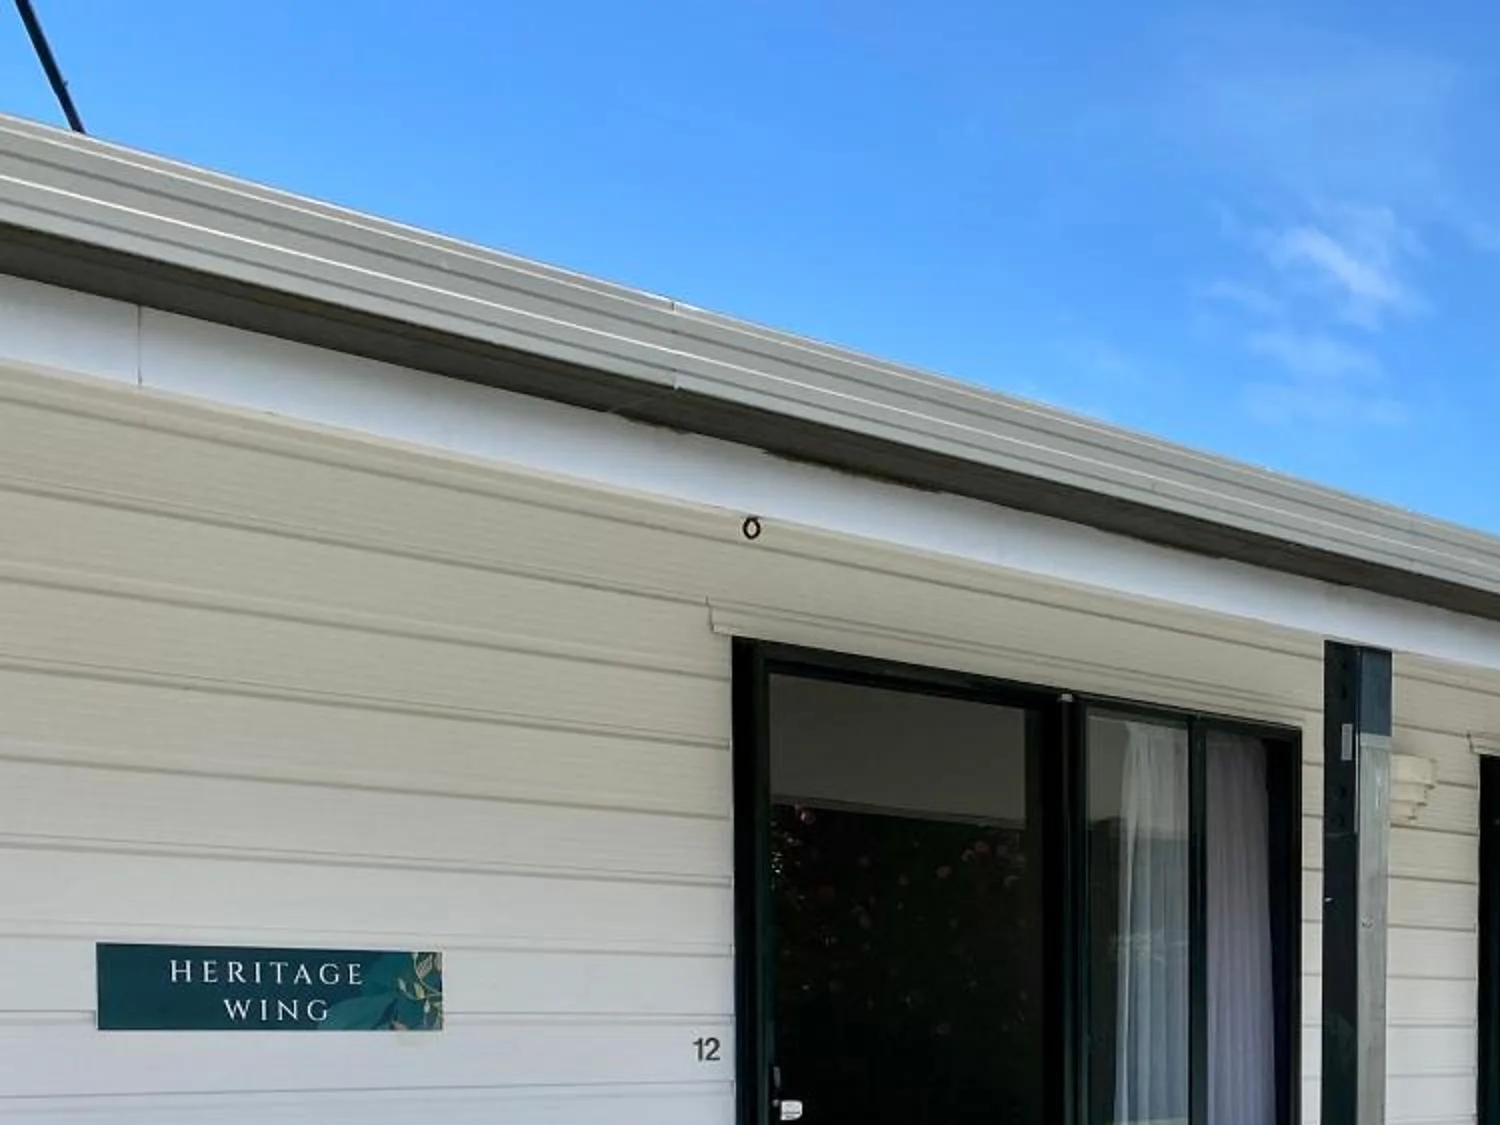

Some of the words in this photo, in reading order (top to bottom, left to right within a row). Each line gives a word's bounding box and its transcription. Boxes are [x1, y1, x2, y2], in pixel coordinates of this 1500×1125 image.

[170, 958, 364, 986] HERITAGE
[223, 998, 329, 1022] WING
[691, 1036, 721, 1062] 12
